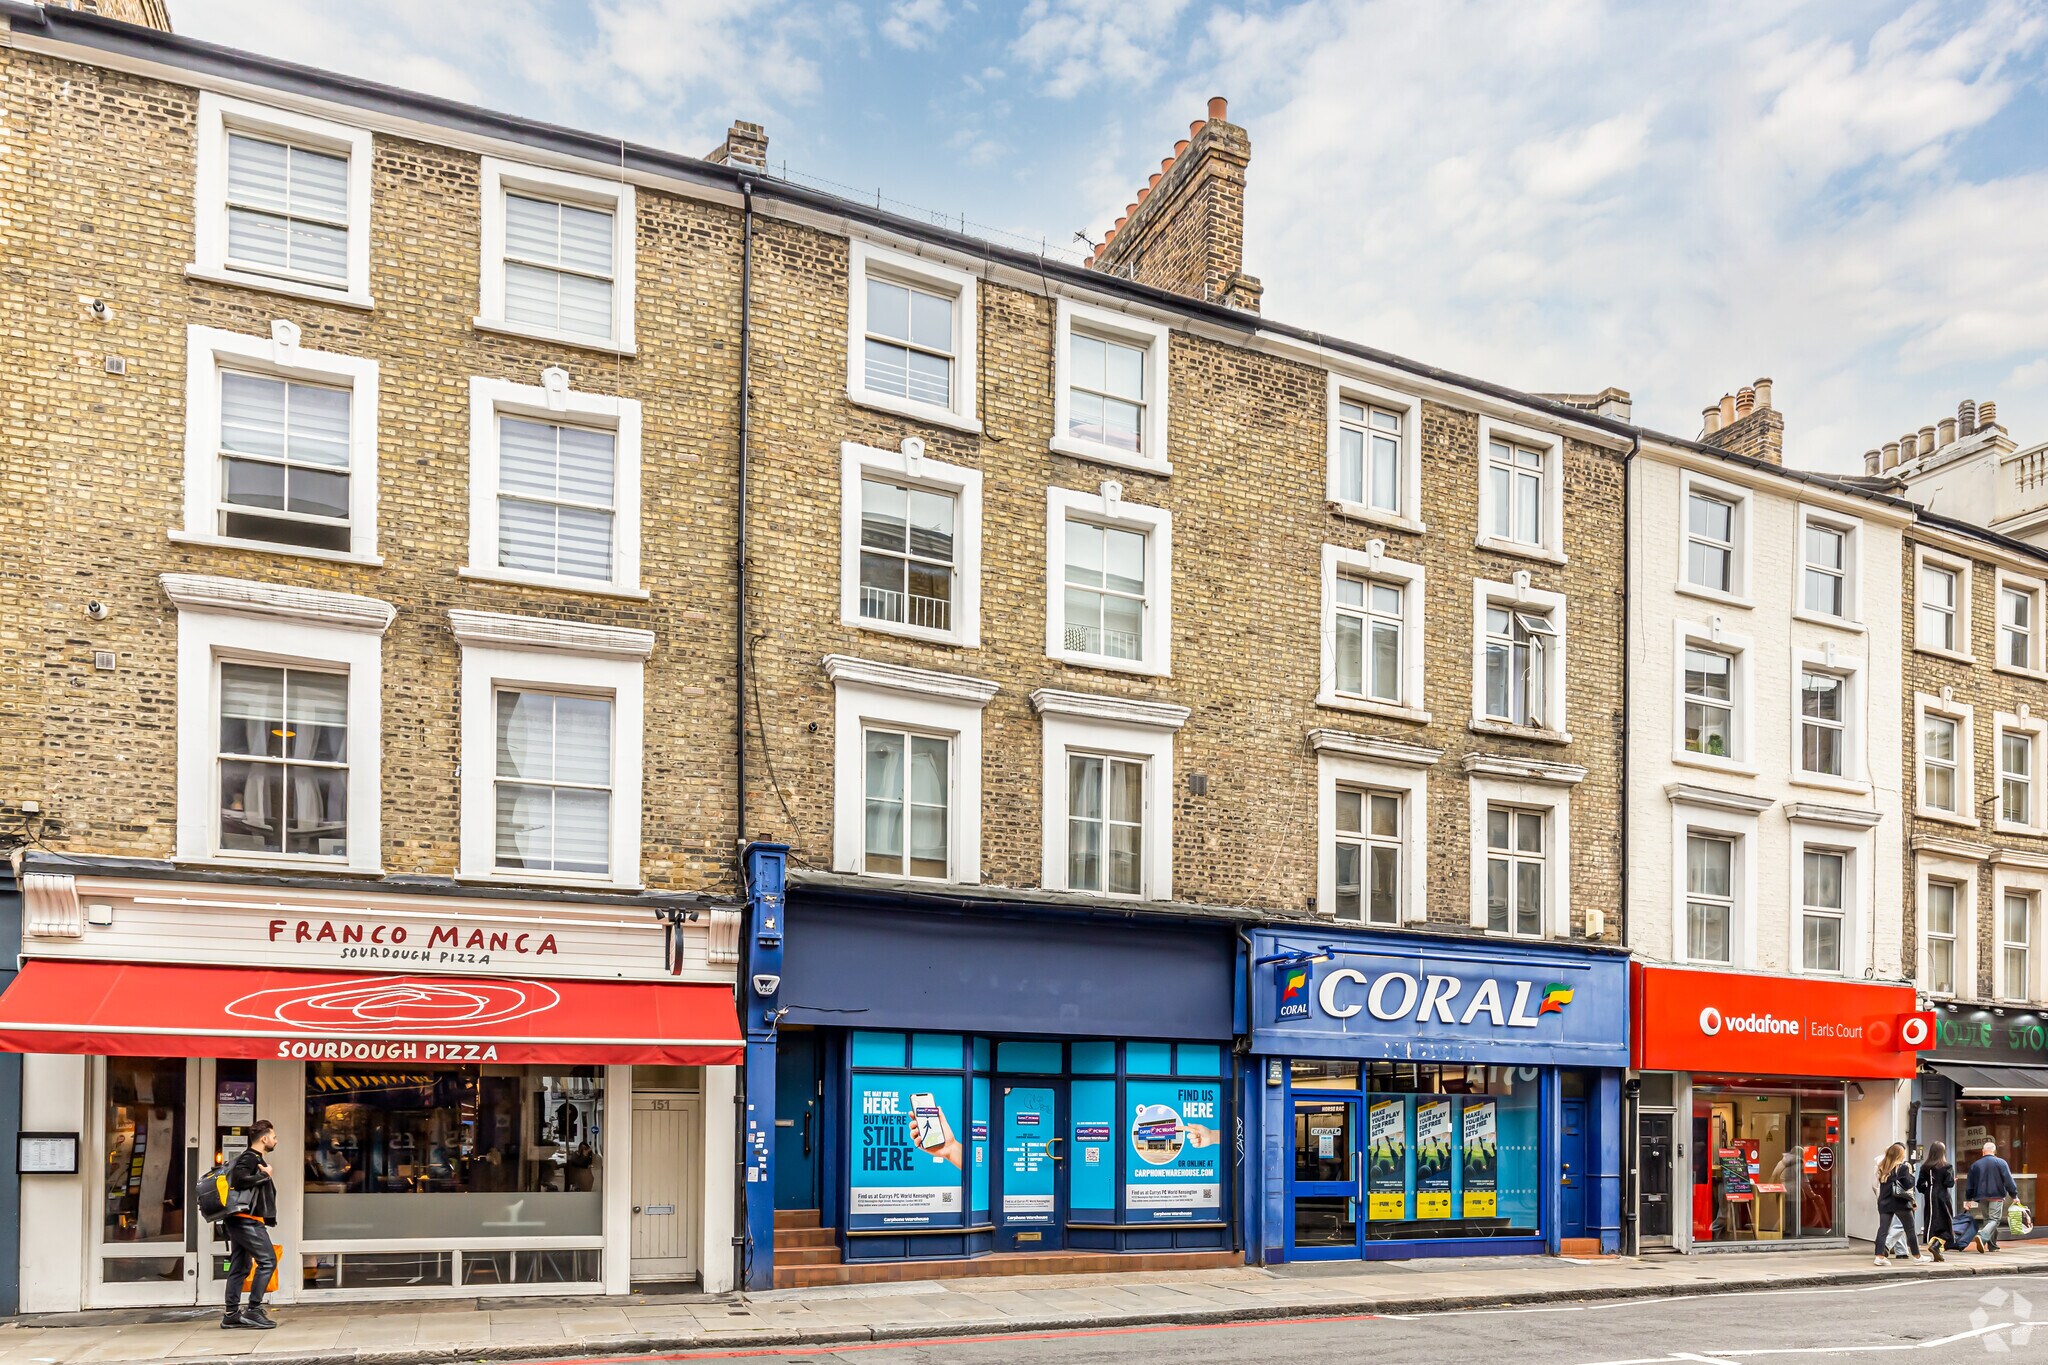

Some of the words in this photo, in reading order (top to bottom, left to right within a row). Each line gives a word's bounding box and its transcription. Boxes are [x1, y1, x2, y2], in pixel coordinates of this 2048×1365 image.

[269, 920, 407, 944] FRANCO
[427, 925, 558, 955] MANCA
[340, 947, 431, 962] SOURDOUGH
[439, 951, 490, 965] PIZZA
[1318, 968, 1540, 1028] CORAL
[1280, 1003, 1308, 1016] CORAL
[1725, 1013, 1799, 1035] vodafone
[1811, 1022, 1834, 1037] Earls
[1836, 1024, 1863, 1039] Court
[2009, 1024, 2048, 1051] STO
[277, 1041, 417, 1059] SOURDOUGH
[425, 1043, 498, 1061] PIZZA
[1178, 1089, 1199, 1101] FIND
[1201, 1089, 1213, 1101] US
[651, 1100, 670, 1110] 151
[863, 1097, 907, 1115] HERE...
[1183, 1102, 1214, 1118] HERE
[1371, 1108, 1386, 1118] MAKE
[1371, 1115, 1385, 1124] YOUR
[1385, 1110, 1400, 1120] PLAY
[1418, 1109, 1433, 1119] MAKE
[1418, 1116, 1432, 1125] YOUR
[1432, 1111, 1447, 1121] PLAY
[1465, 1110, 1481, 1120] MAKE
[1465, 1117, 1480, 1125] YOUR
[1479, 1112, 1492, 1121] PLAY
[863, 1115, 881, 1125] BUT
[881, 1115, 907, 1125] WE'RE
[1381, 1118, 1395, 1127] FREE
[1428, 1119, 1442, 1128] FREE
[1465, 1124, 1475, 1132] FOR
[1475, 1119, 1487, 1128] FREE
[863, 1126, 907, 1146] STILL
[1967, 1128, 1984, 1136] ARE
[863, 1148, 914, 1171] HERE
[1134, 1168, 1214, 1177] CARPHONEWAREHOUSE.COM
